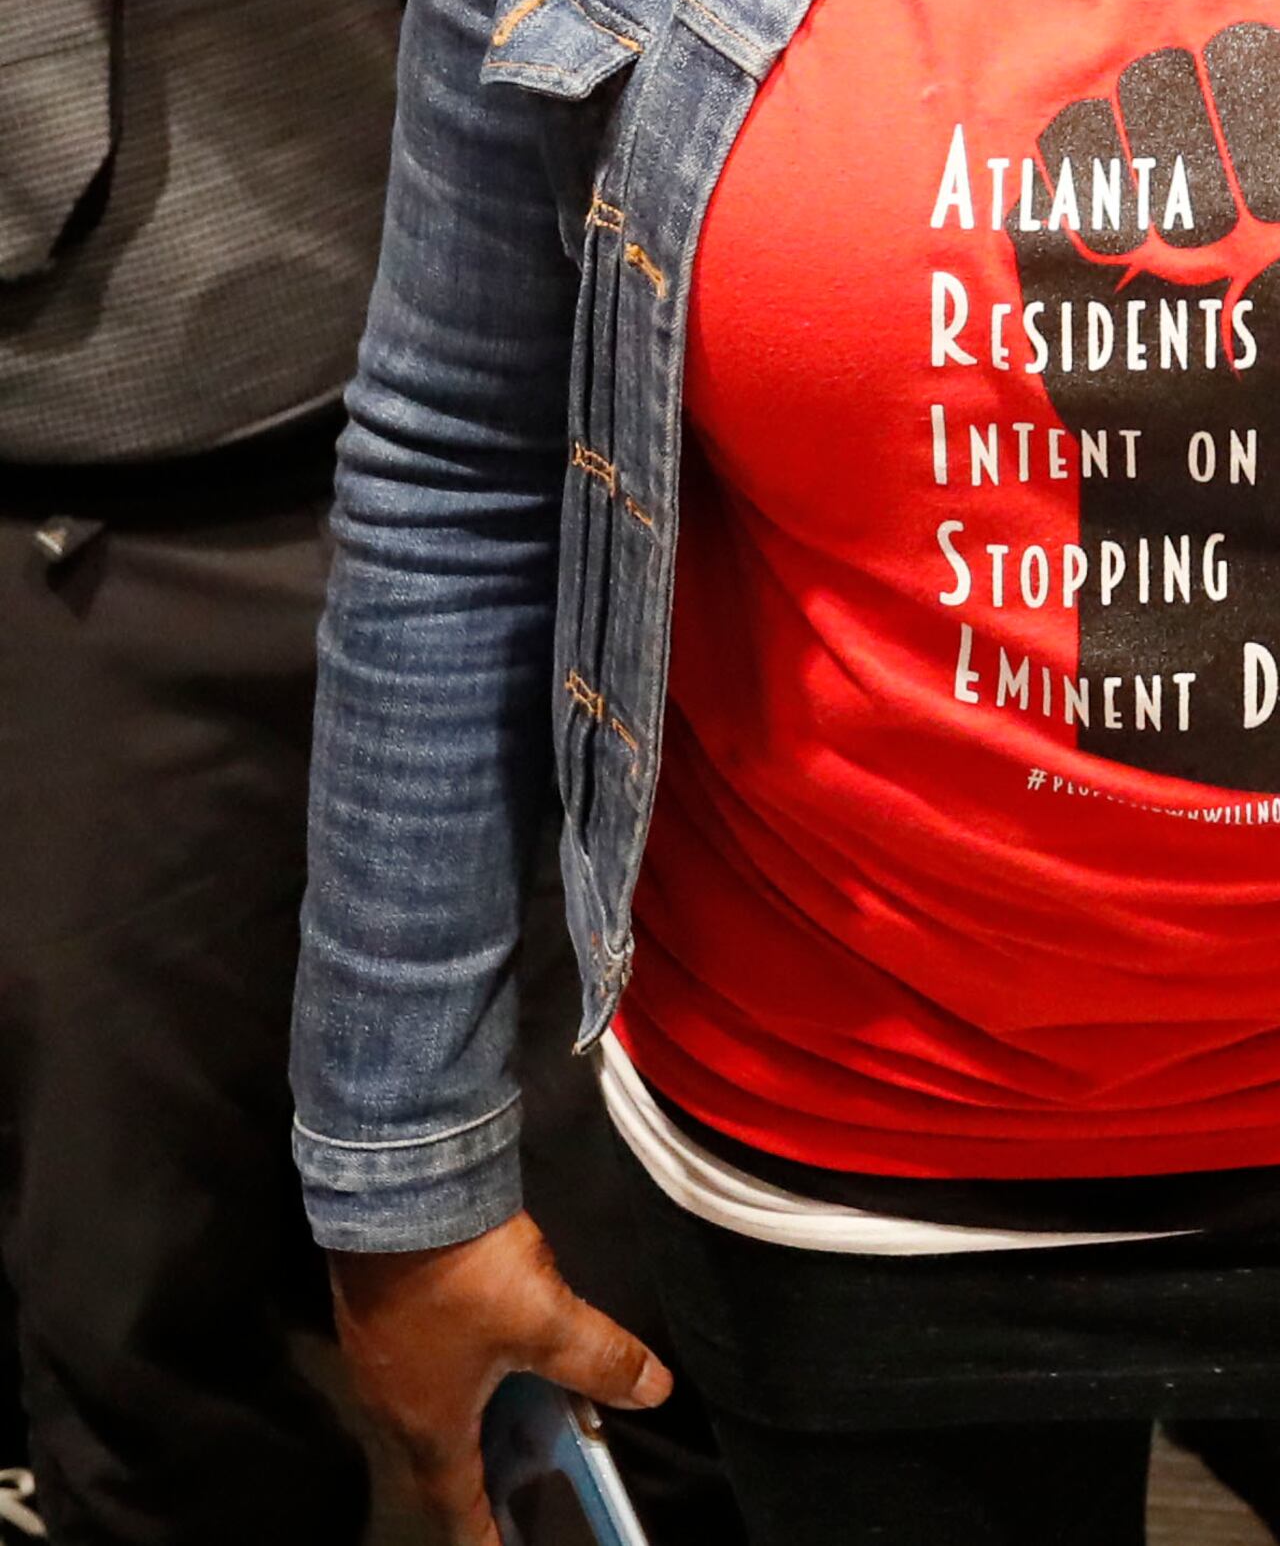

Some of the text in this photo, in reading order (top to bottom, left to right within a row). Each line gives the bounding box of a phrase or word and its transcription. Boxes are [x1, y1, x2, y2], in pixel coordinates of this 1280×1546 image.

[929, 123, 1196, 231] ATLANTA
[930, 270, 1258, 372] RESIDENTS
[930, 404, 1257, 486] INTENT ON
[936, 520, 1229, 608] STOPPING
[953, 623, 1197, 732] EMINENT
